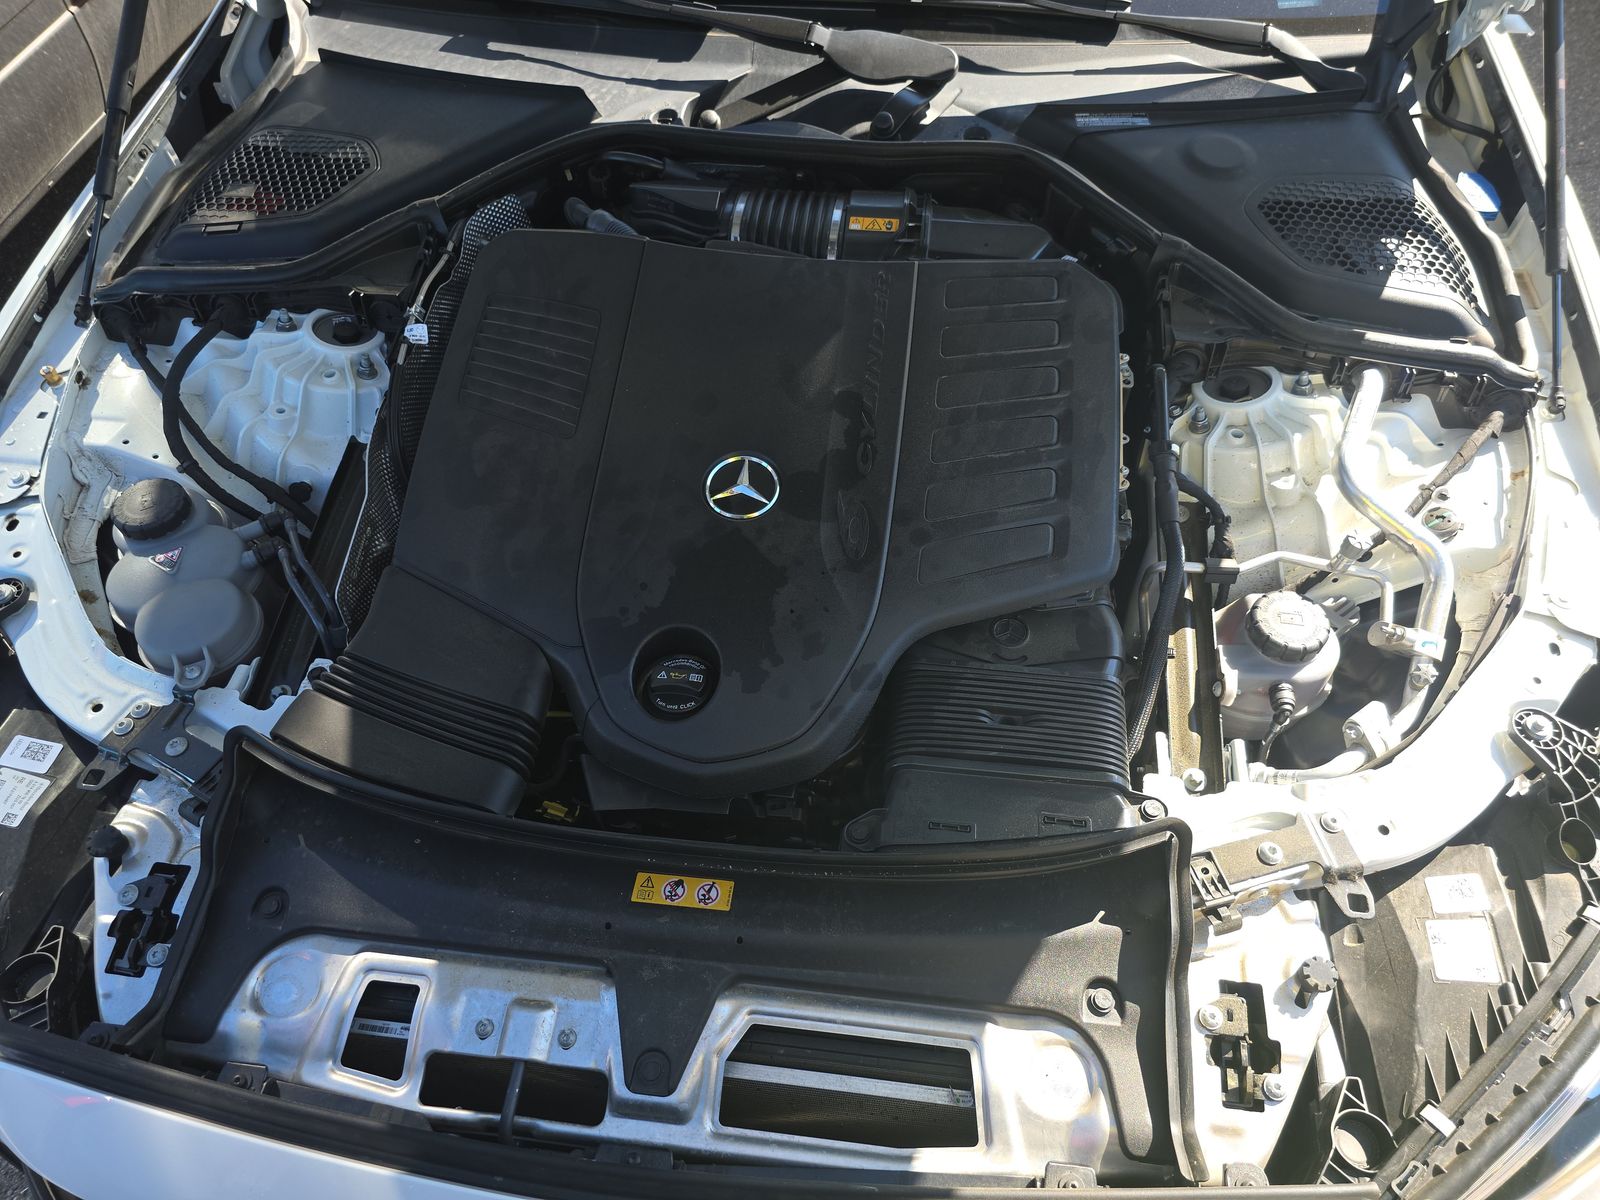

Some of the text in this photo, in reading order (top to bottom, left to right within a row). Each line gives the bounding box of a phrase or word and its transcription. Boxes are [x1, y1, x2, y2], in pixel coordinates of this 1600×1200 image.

[856, 269, 892, 475] CYLINDER
[656, 698, 666, 706] Turn
[680, 701, 696, 710] CLICK
